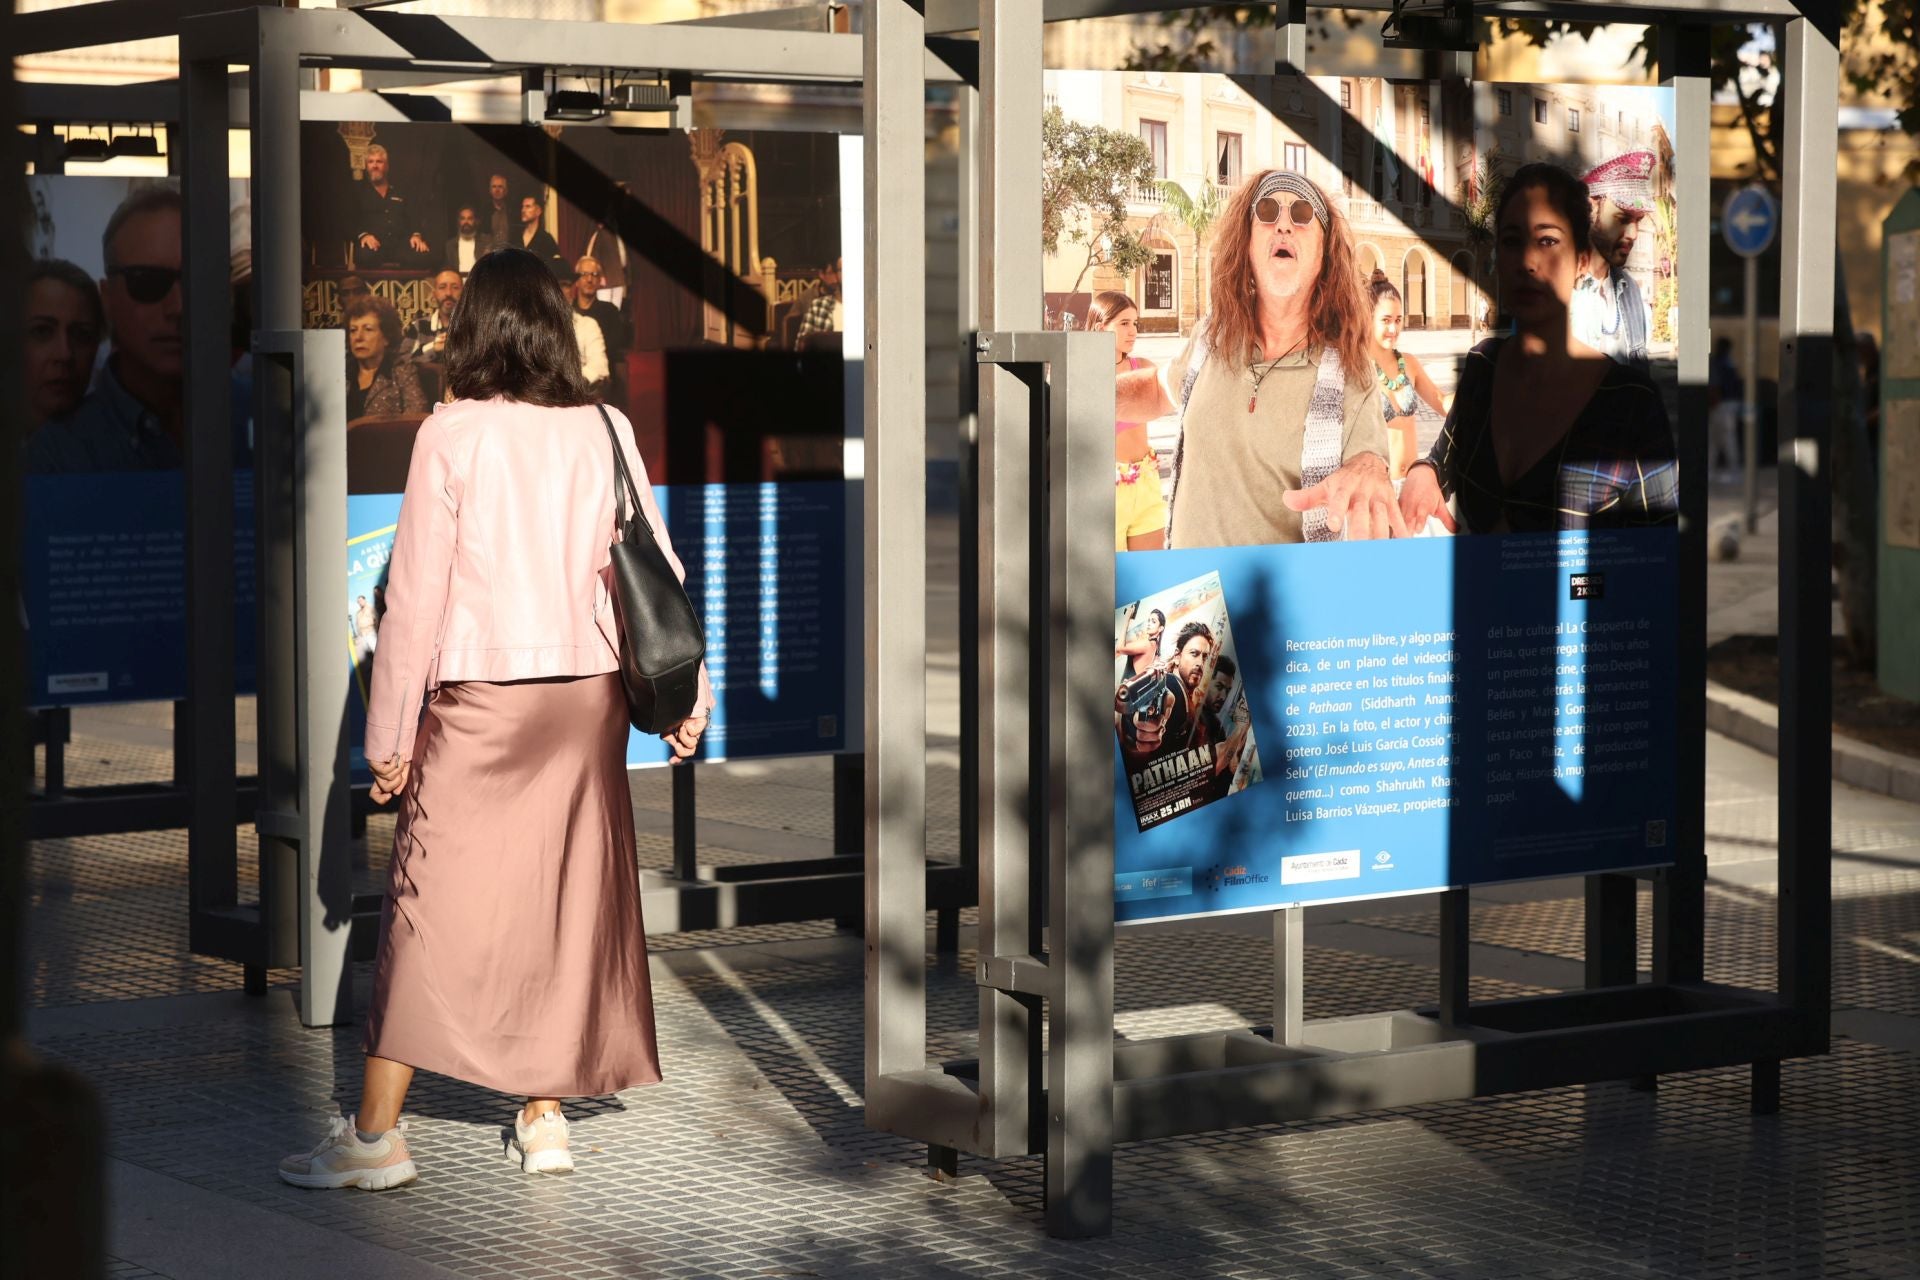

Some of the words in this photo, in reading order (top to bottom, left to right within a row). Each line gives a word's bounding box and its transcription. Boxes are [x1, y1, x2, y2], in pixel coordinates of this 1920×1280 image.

[1566, 621, 1577, 633] La
[1286, 637, 1344, 652] Recreación
[1347, 636, 1369, 648] muy
[1373, 633, 1398, 647] libre,
[1401, 636, 1406, 647] y
[1409, 632, 1431, 647] algo
[1286, 660, 1311, 673] dica,
[1318, 659, 1330, 671] de
[1337, 659, 1350, 669] un
[1357, 656, 1386, 671] plano
[1392, 653, 1408, 665] del
[1414, 650, 1460, 664] videoclip
[1286, 684, 1306, 697] que
[1311, 680, 1352, 694] aparece
[1356, 679, 1369, 689] en
[1373, 676, 1388, 689] los
[1392, 673, 1424, 687] títulos
[1428, 672, 1460, 685] finales
[1286, 703, 1299, 716] de
[1309, 701, 1352, 714] Pathaan
[1362, 695, 1415, 712] (Siddharth
[1286, 725, 1318, 737] 2023).
[1323, 722, 1335, 734] En
[1341, 721, 1349, 733] la
[1353, 719, 1377, 733] foto,
[1381, 718, 1390, 730] el
[1394, 716, 1420, 729] actor
[1424, 717, 1430, 729] y
[1286, 747, 1321, 761] gotero
[1325, 742, 1348, 756] José
[1352, 741, 1372, 753] Luis
[1376, 737, 1408, 751] García
[1412, 735, 1445, 747] Cossío
[1131, 744, 1212, 794] PATHAAN
[1314, 764, 1328, 778] (El
[1330, 762, 1365, 776] mundo
[1368, 762, 1378, 772] es
[1380, 761, 1405, 773] suyo,
[1408, 756, 1435, 769] Antes
[1437, 755, 1449, 767] de
[1340, 785, 1369, 796] como
[1376, 779, 1425, 793] Shahrukh
[1160, 805, 1172, 818] 25
[1173, 797, 1192, 812] JAN
[1286, 809, 1312, 822] Luisa
[1317, 805, 1352, 819] Barrios
[1356, 800, 1400, 816] Vázquez,
[1404, 796, 1459, 812] propietaria
[1224, 874, 1268, 886] FilmOffice
